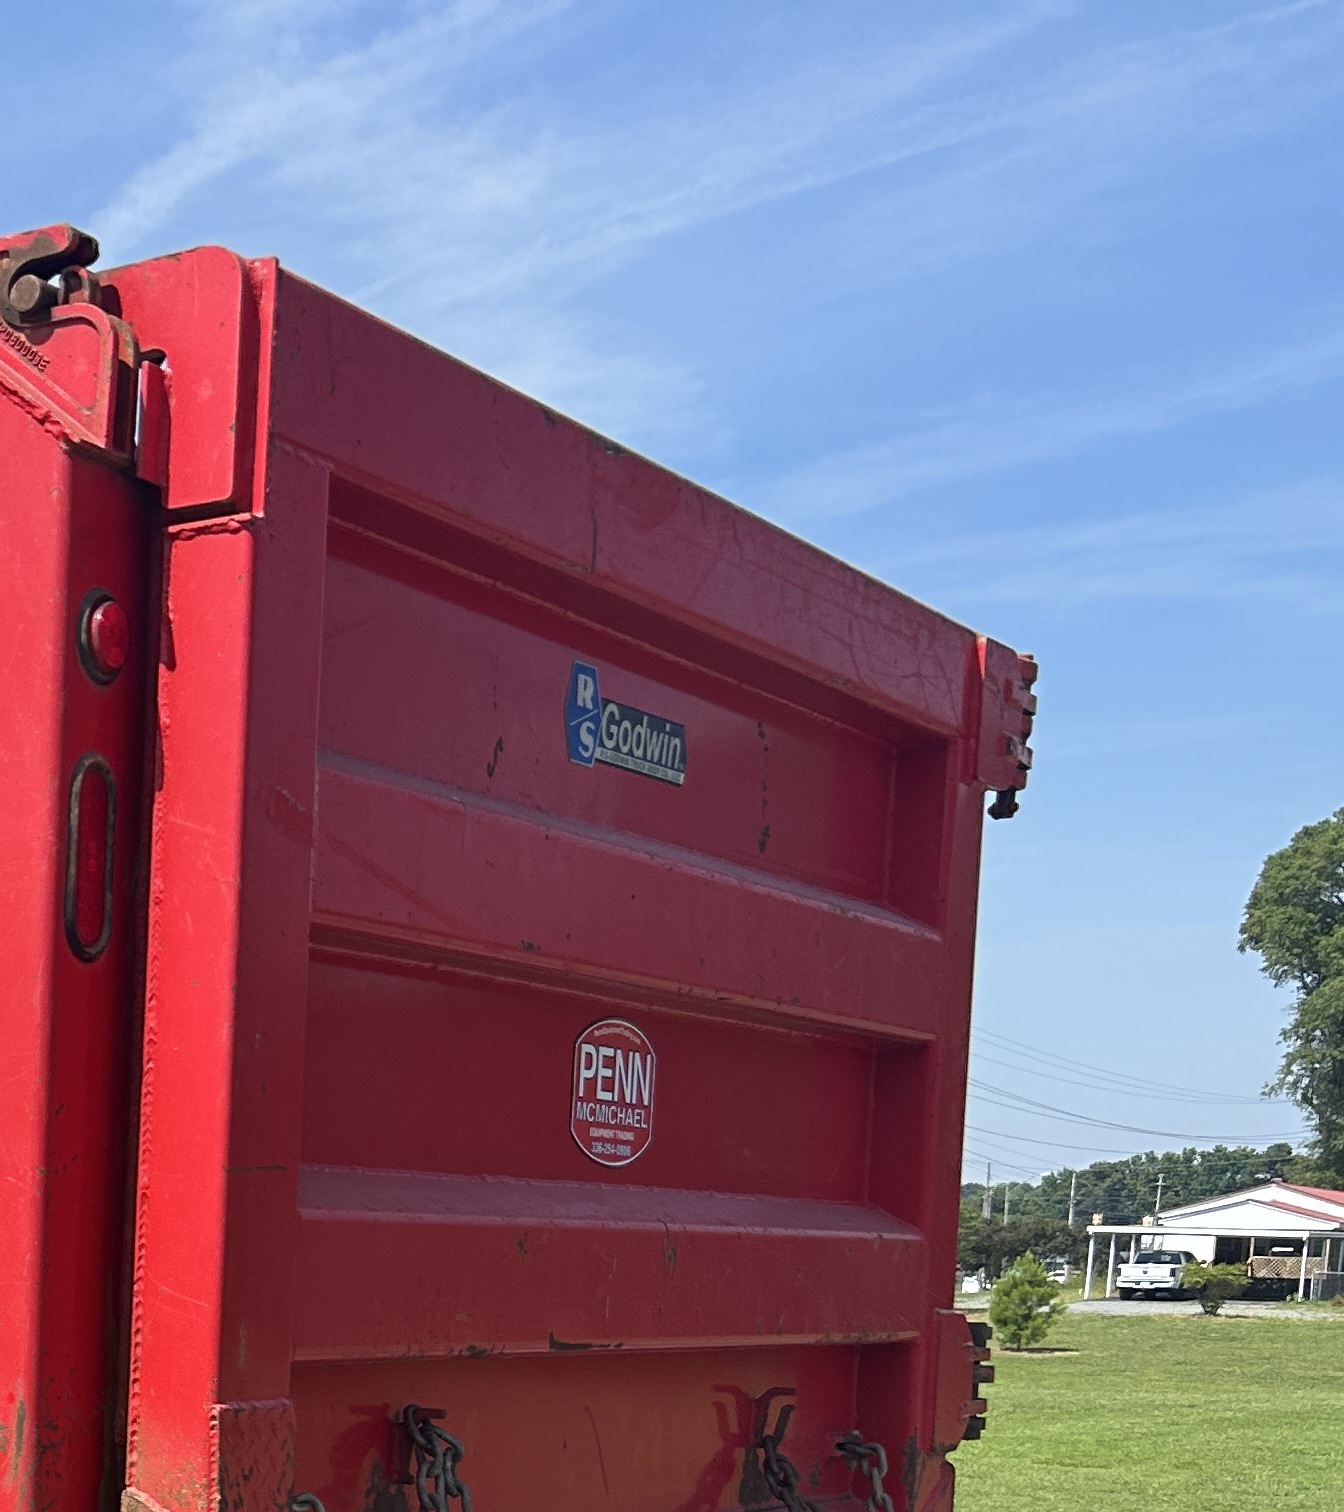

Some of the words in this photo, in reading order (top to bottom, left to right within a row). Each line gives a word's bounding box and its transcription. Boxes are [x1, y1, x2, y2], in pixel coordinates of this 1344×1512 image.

[601, 702, 682, 769] Godwin
[578, 1043, 652, 1107] PENN
[576, 1101, 648, 1129] MCMICHAEL
